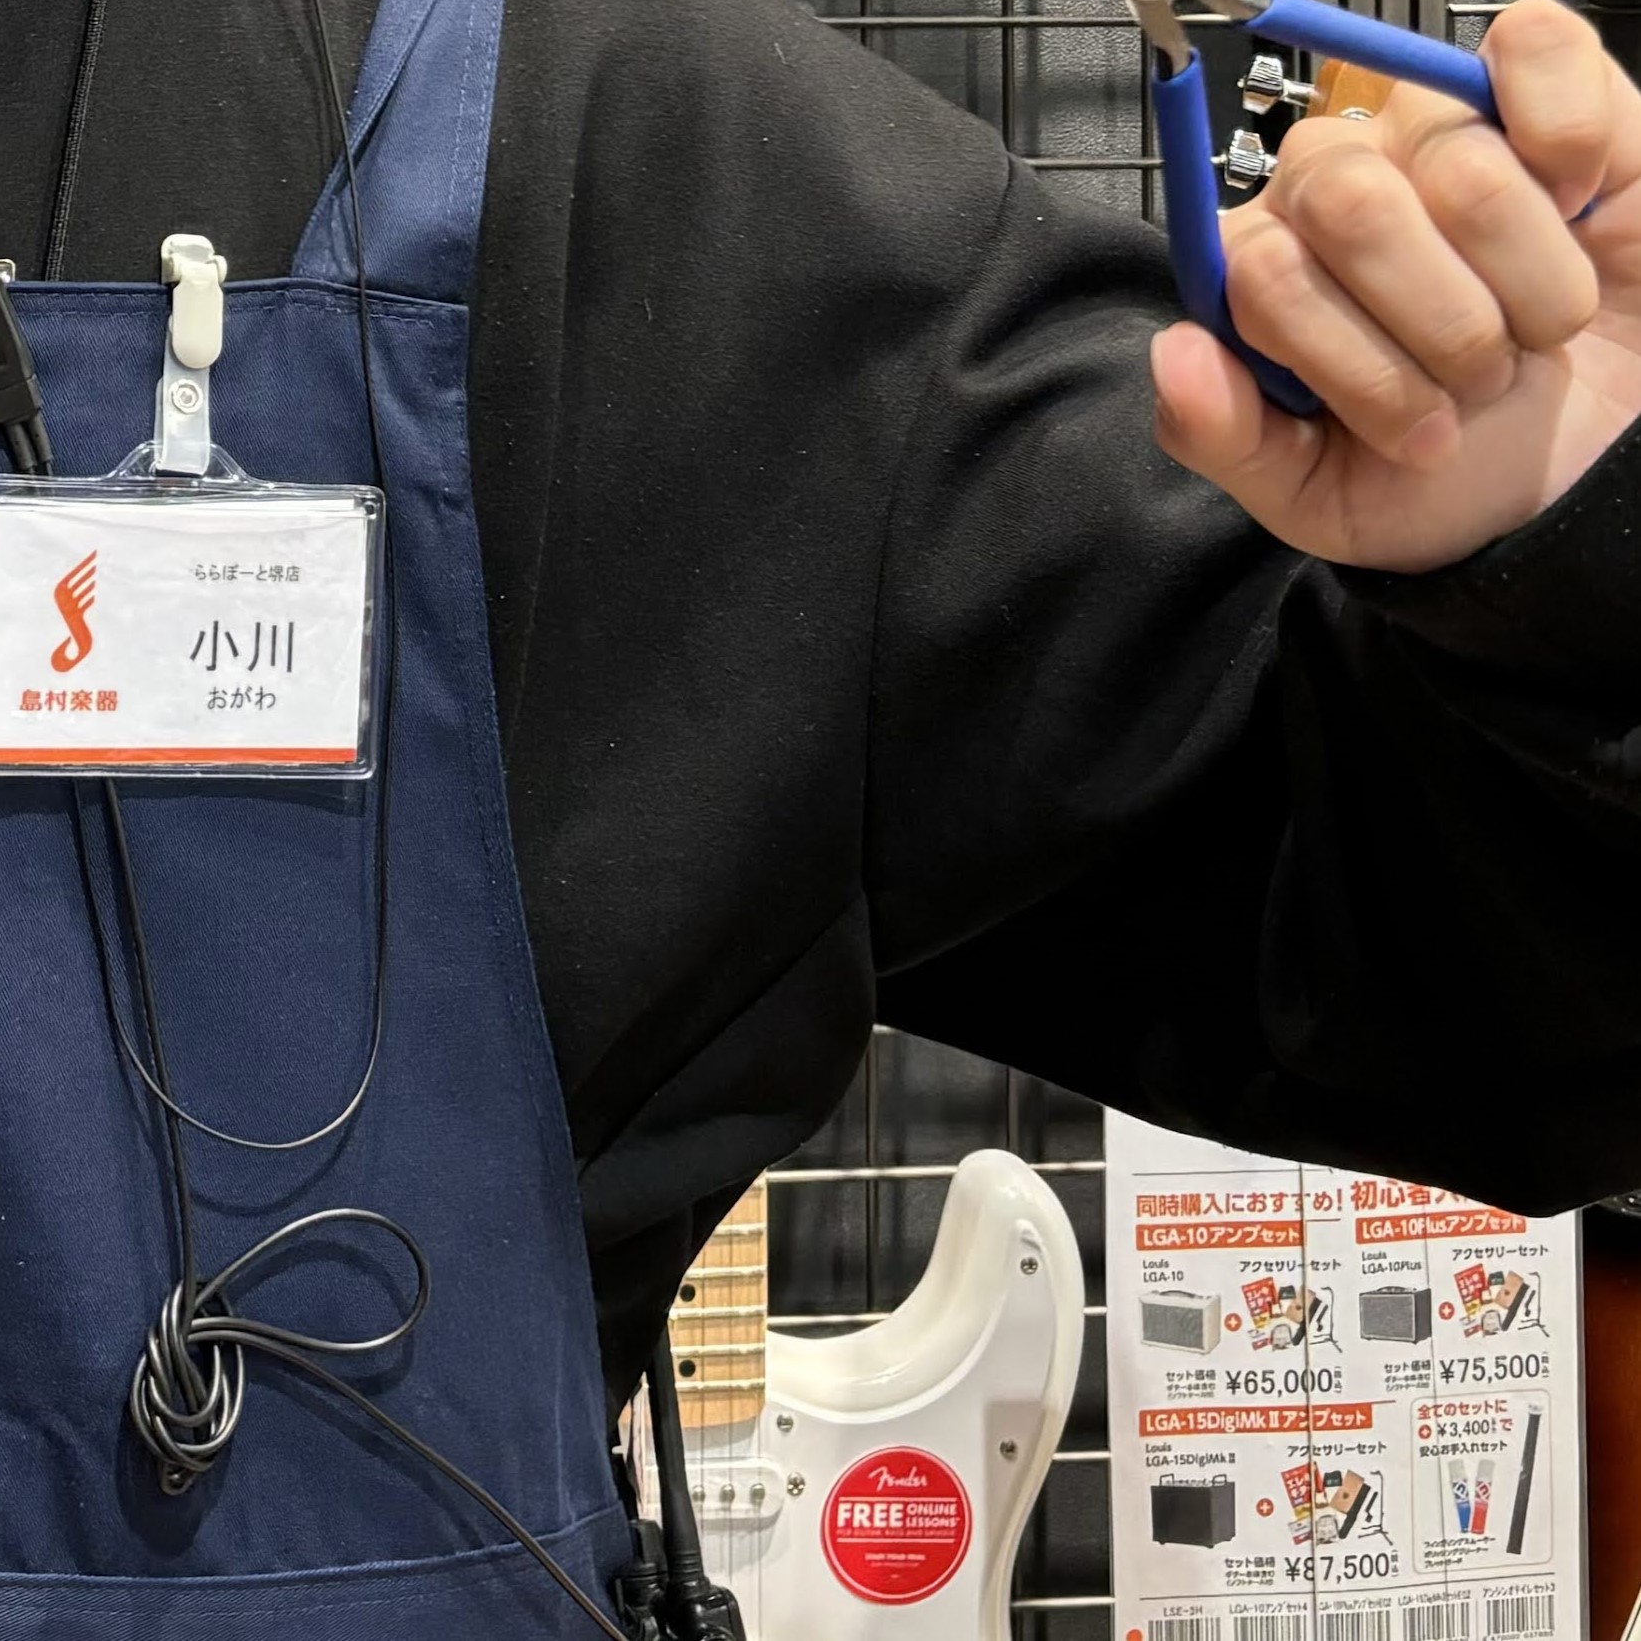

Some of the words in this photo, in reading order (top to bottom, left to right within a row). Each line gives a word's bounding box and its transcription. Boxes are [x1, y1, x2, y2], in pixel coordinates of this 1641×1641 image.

[190, 620, 294, 673] 小川
[19, 689, 119, 712] 島村楽器
[207, 686, 277, 710] おがわ
[1143, 1225, 1300, 1247] LGA-10アンプセット
[1361, 1250, 1388, 1262] Louis
[1451, 1244, 1549, 1261] アクセサリーセット
[1143, 1259, 1170, 1269] Louis
[1239, 1258, 1342, 1273] アクセサリーセット
[1143, 1270, 1184, 1283] LGA-10
[1439, 1353, 1541, 1385] ¥75,500
[1225, 1368, 1333, 1398] ¥65,000
[1417, 1399, 1508, 1421] 全てのセットに
[1437, 1419, 1490, 1438] ¥3,400
[1145, 1442, 1172, 1453] Louis
[1287, 1441, 1387, 1457] アクセサリーセット
[868, 1466, 928, 1492] Fender
[837, 1502, 905, 1528] FREE
[906, 1502, 957, 1516] ONLINE
[1284, 1553, 1390, 1584] ¥87,500
